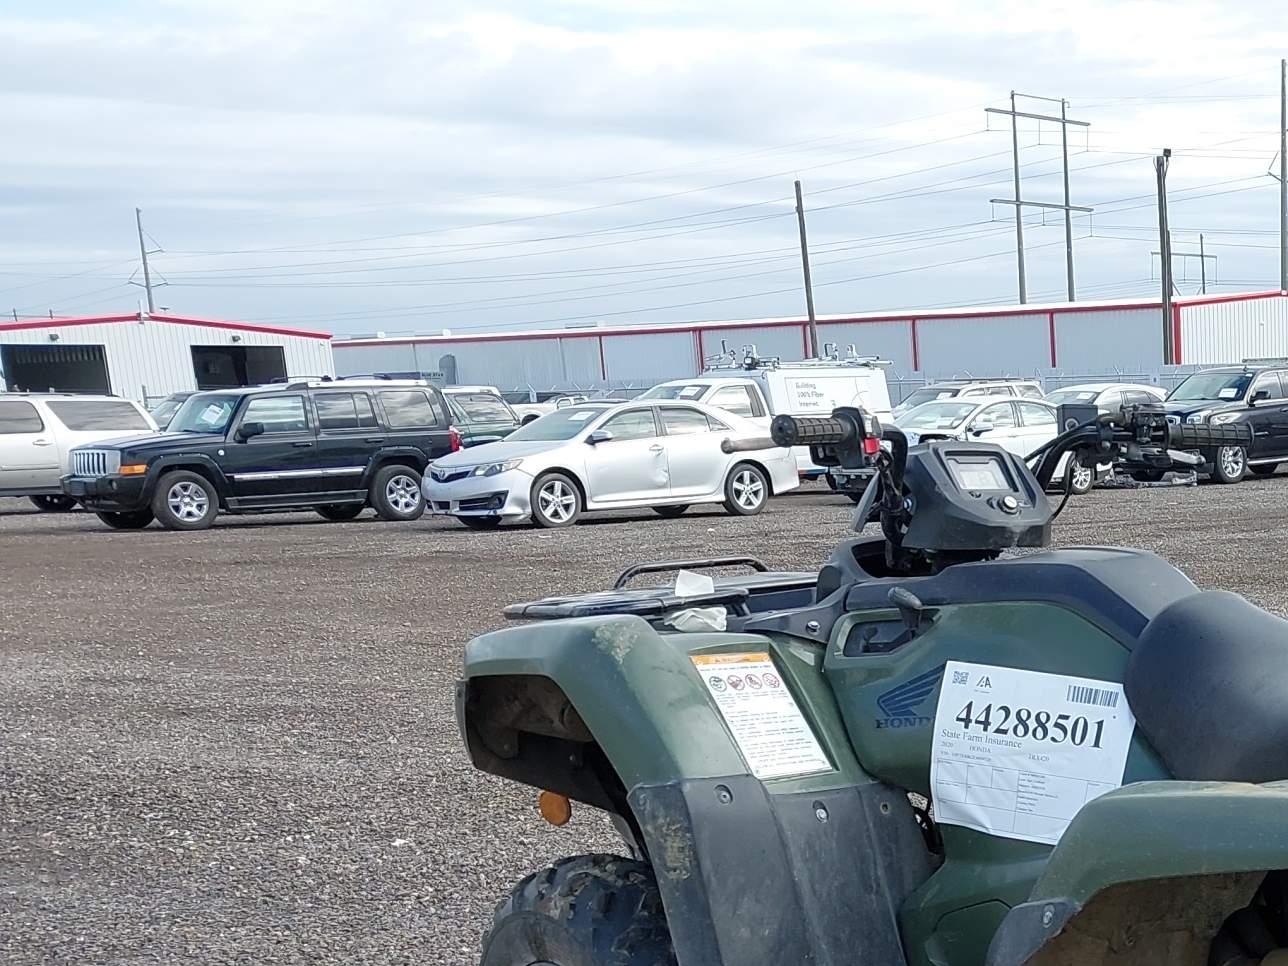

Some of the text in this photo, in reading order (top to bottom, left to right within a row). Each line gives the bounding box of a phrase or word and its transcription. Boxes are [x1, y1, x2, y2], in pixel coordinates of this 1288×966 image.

[875, 716, 935, 729] HOND
[955, 700, 1105, 750] 44288501
[941, 728, 1022, 749] State Farm Insurance
